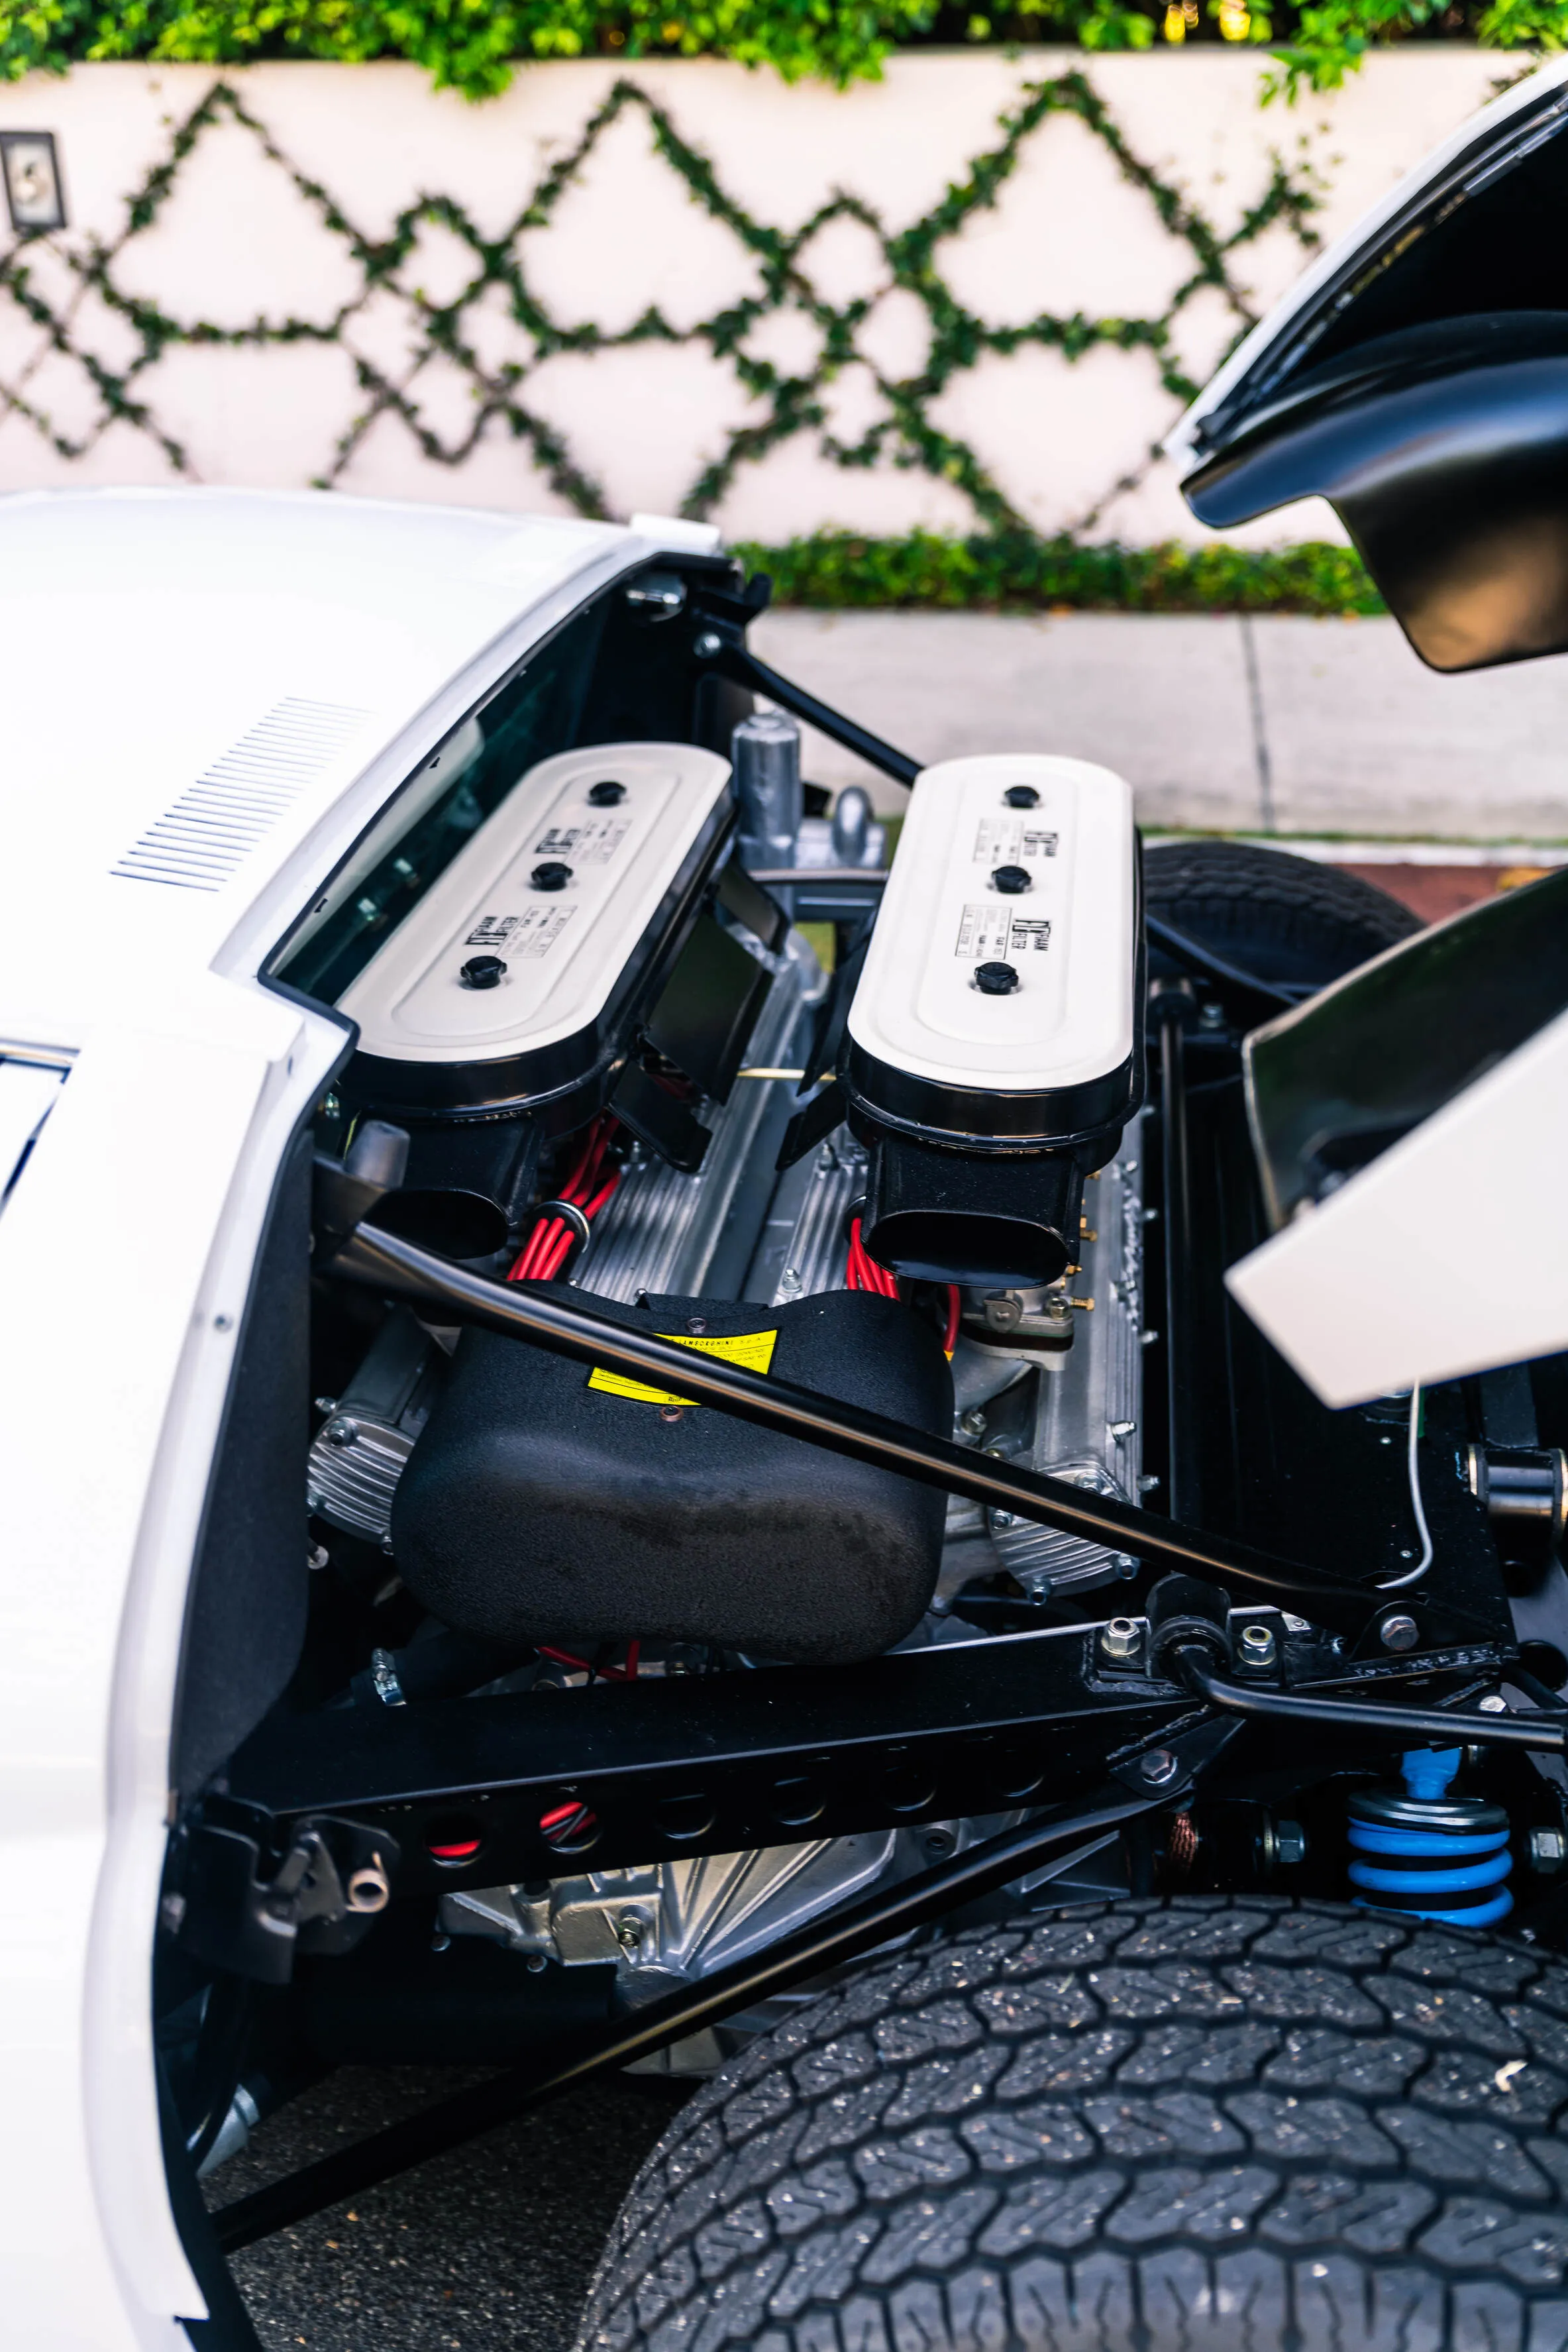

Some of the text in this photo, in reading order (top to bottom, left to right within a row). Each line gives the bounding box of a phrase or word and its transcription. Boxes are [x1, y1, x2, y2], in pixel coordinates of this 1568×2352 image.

[474, 916, 498, 934] FIAAM
[495, 916, 519, 934] FILTER
[1011, 932, 1027, 950] FILTER
[1033, 932, 1049, 951] FIAAM
